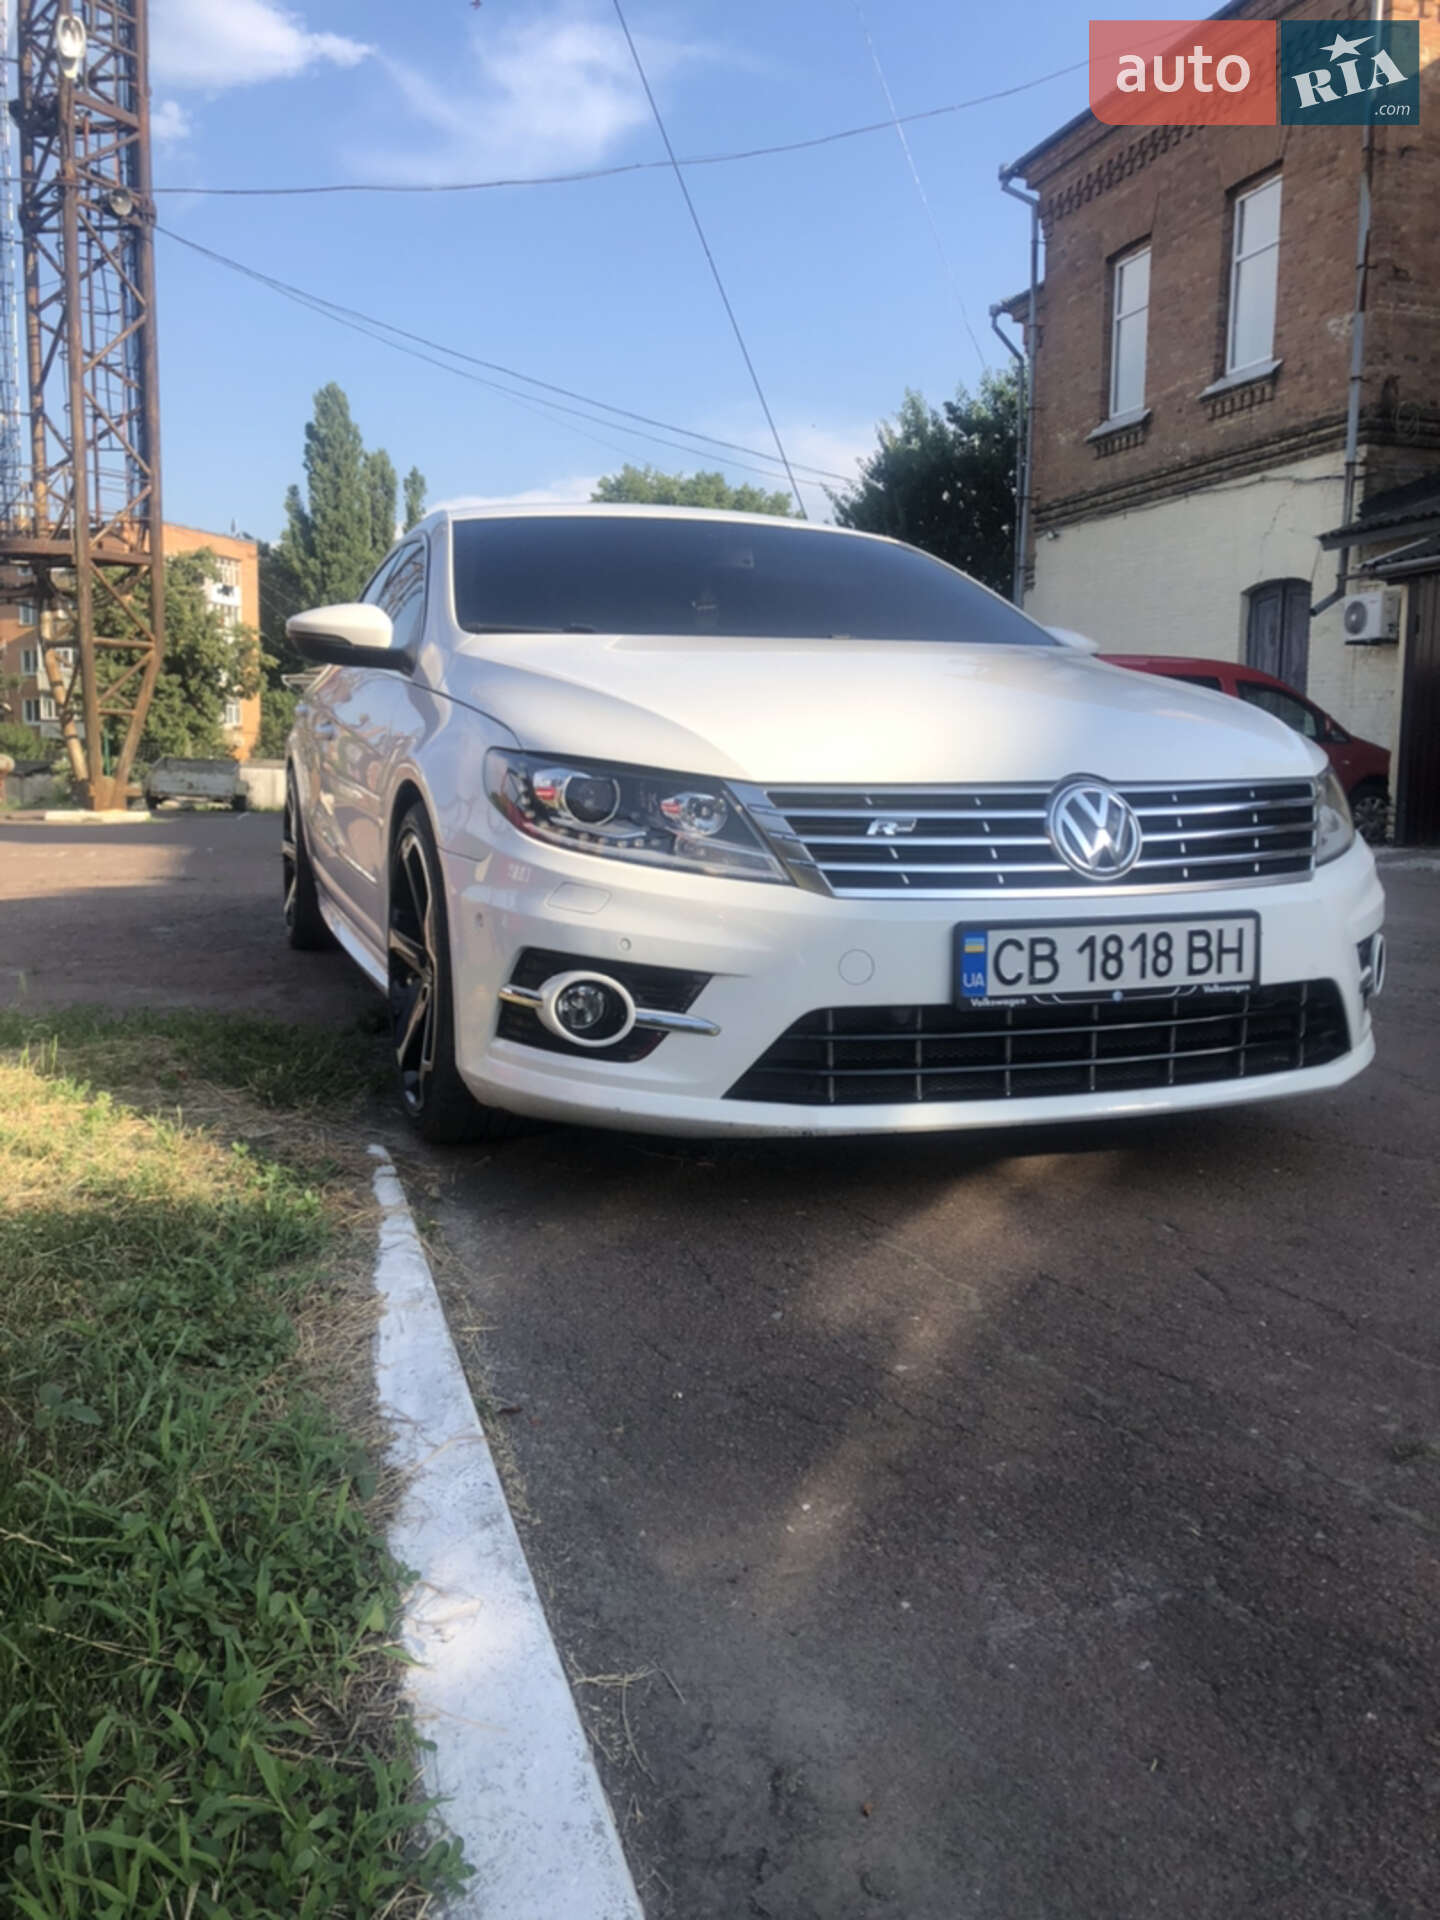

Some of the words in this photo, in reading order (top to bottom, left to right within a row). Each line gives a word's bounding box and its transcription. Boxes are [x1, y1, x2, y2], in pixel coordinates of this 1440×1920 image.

[992, 936, 1060, 986] CB
[1077, 931, 1173, 983] 1818
[1186, 927, 1245, 977] BH
[963, 973, 985, 988] UA
